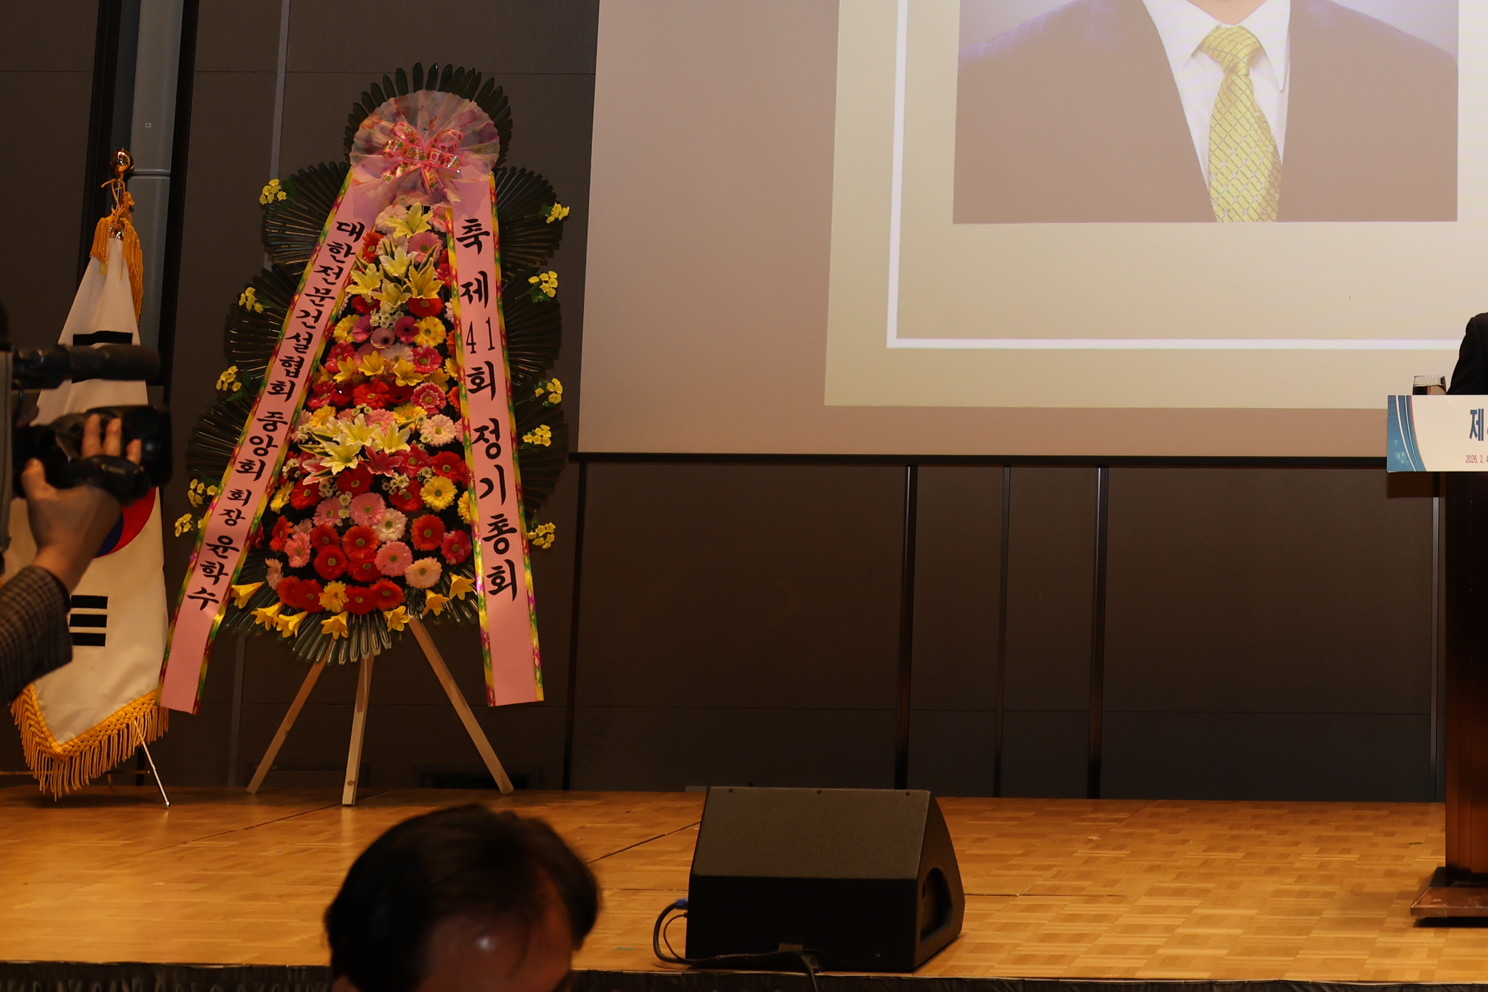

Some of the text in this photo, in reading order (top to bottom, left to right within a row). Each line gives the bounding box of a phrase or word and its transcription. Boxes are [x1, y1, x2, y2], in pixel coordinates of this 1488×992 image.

[187, 221, 366, 611] 대한전문건설협회 중앙회 회장 윤학수
[456, 217, 517, 602] 축 제41회 정기총회
